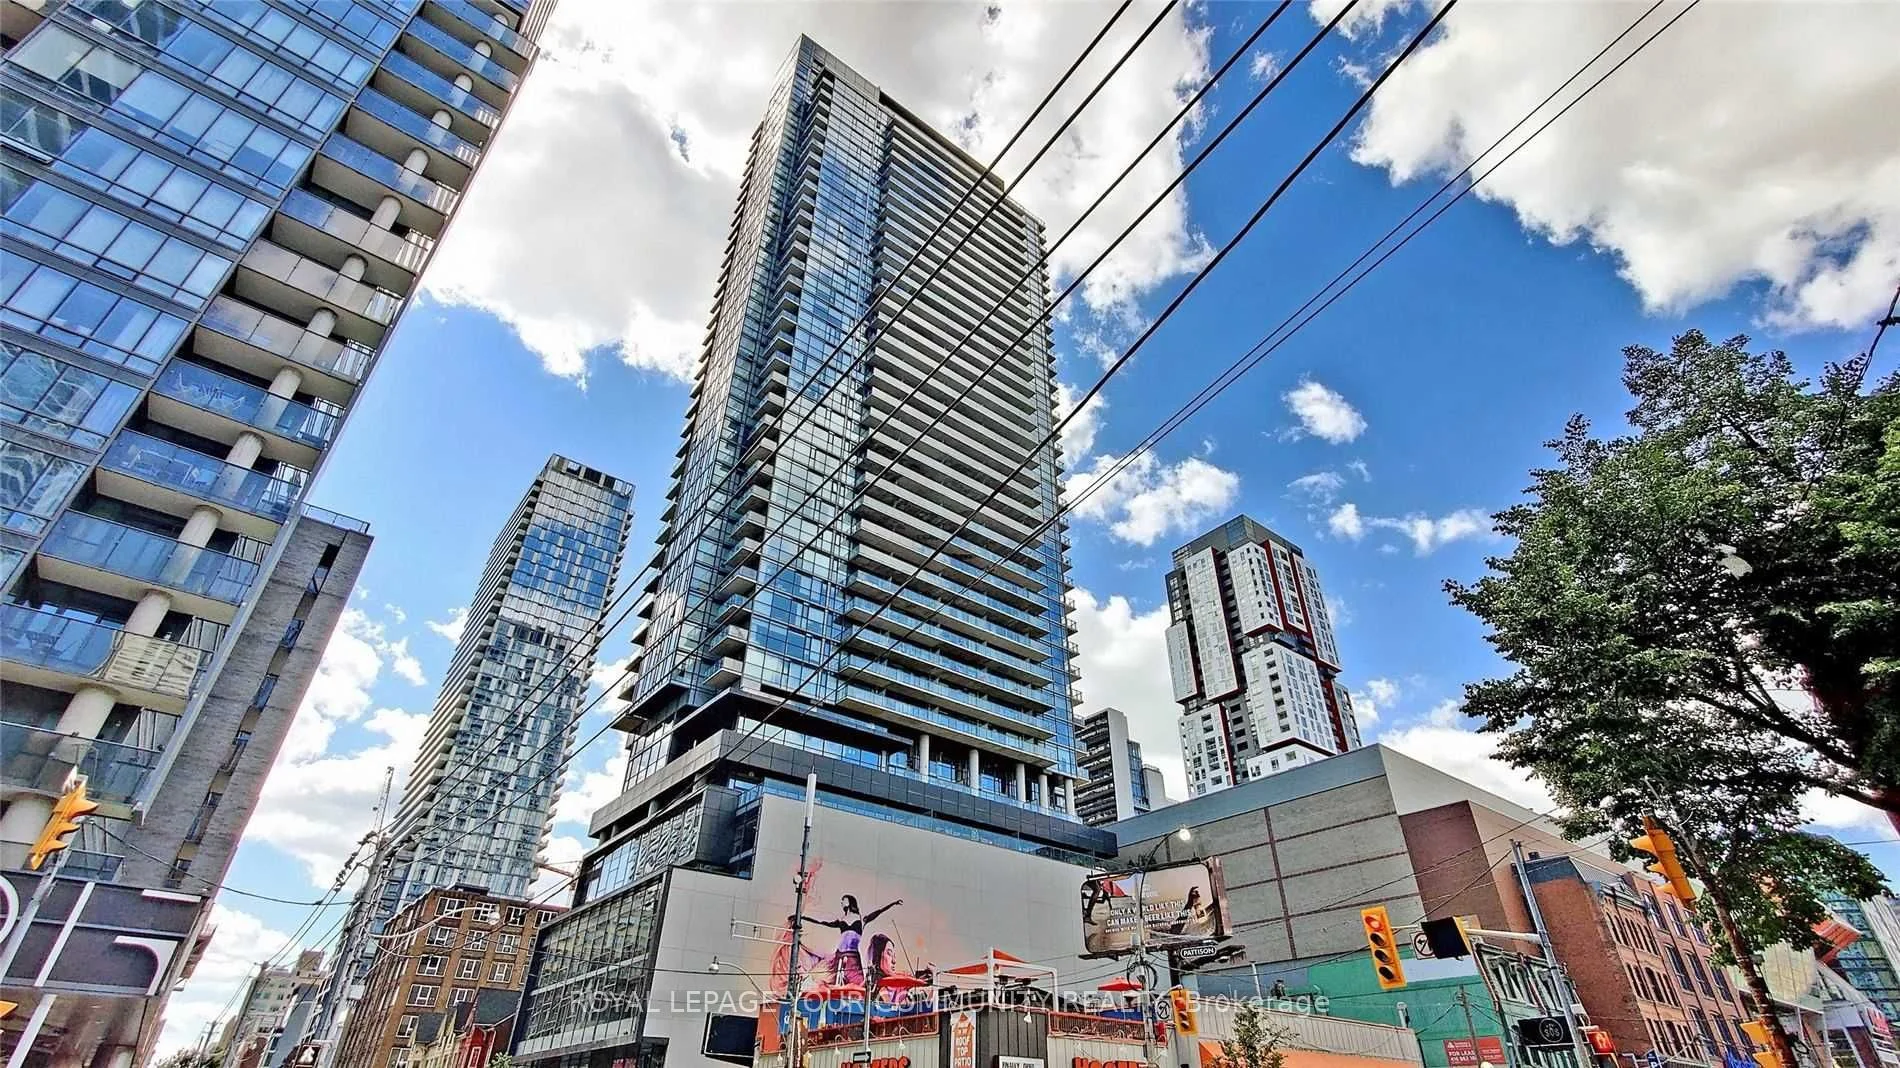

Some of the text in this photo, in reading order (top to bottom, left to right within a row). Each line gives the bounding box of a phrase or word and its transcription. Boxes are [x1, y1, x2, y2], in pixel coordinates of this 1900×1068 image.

[1110, 908, 1126, 917] ONLY
[1106, 918, 1120, 927] CAN
[1120, 916, 1137, 925] MAKE
[1144, 914, 1160, 922] BEER
[1183, 948, 1214, 956] PATTISON
[957, 1047, 968, 1056] TOP
[954, 1057, 972, 1066] PATIO
